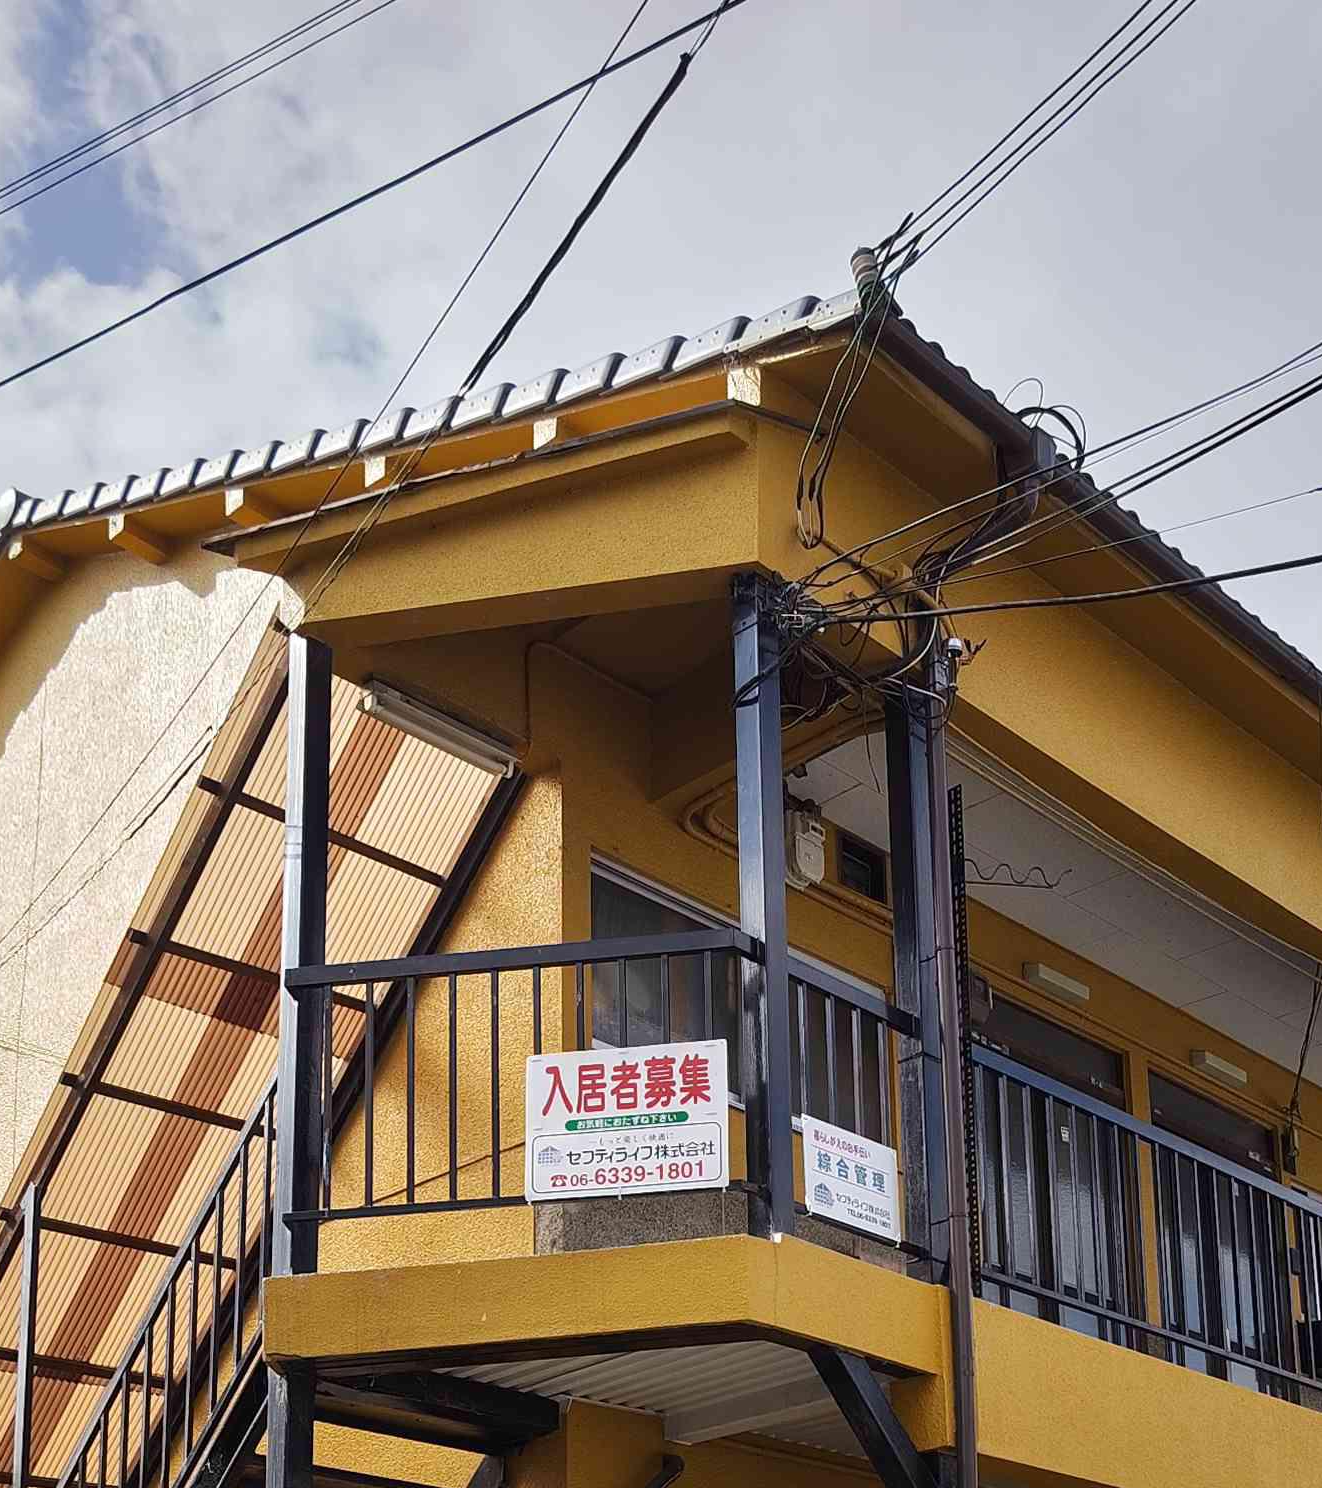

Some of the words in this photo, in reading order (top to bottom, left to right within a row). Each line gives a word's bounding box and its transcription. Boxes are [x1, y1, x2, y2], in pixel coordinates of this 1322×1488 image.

[542, 1054, 712, 1117] 入居者募集
[566, 1139, 717, 1166] セフティライフ株式会社
[570, 1159, 705, 1187] 06-6339-1801
